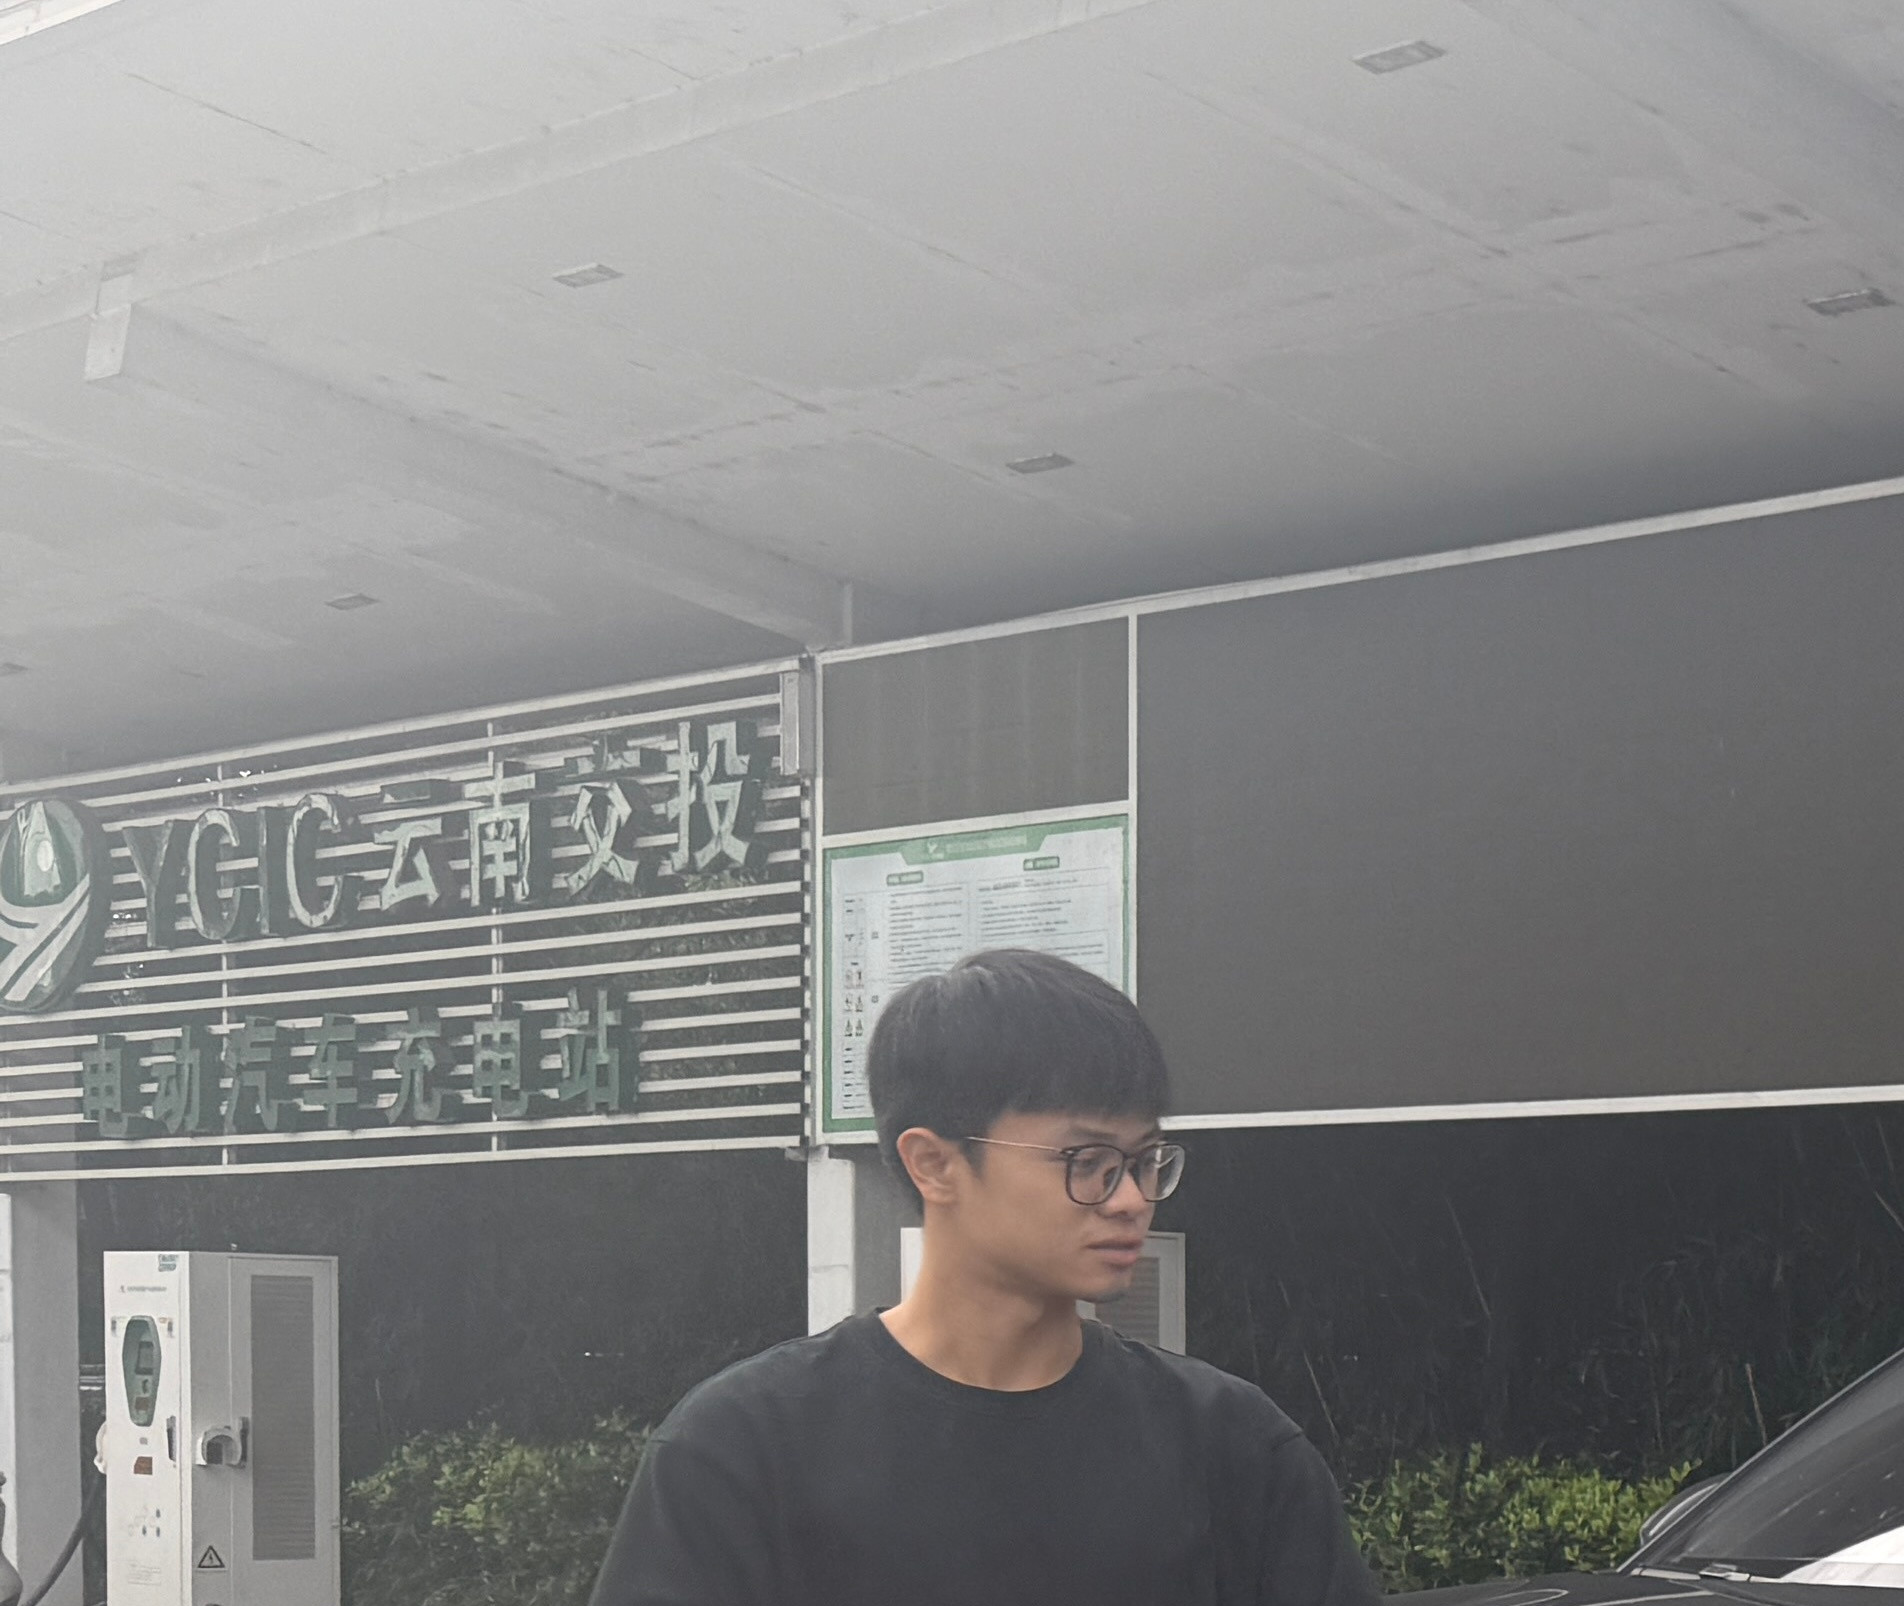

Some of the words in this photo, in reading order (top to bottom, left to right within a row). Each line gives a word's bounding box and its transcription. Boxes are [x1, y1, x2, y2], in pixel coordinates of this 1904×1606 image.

[122, 793, 344, 948] YCIC
[373, 720, 751, 911] 云南交投
[82, 986, 622, 1139] 电动汽车充电站
